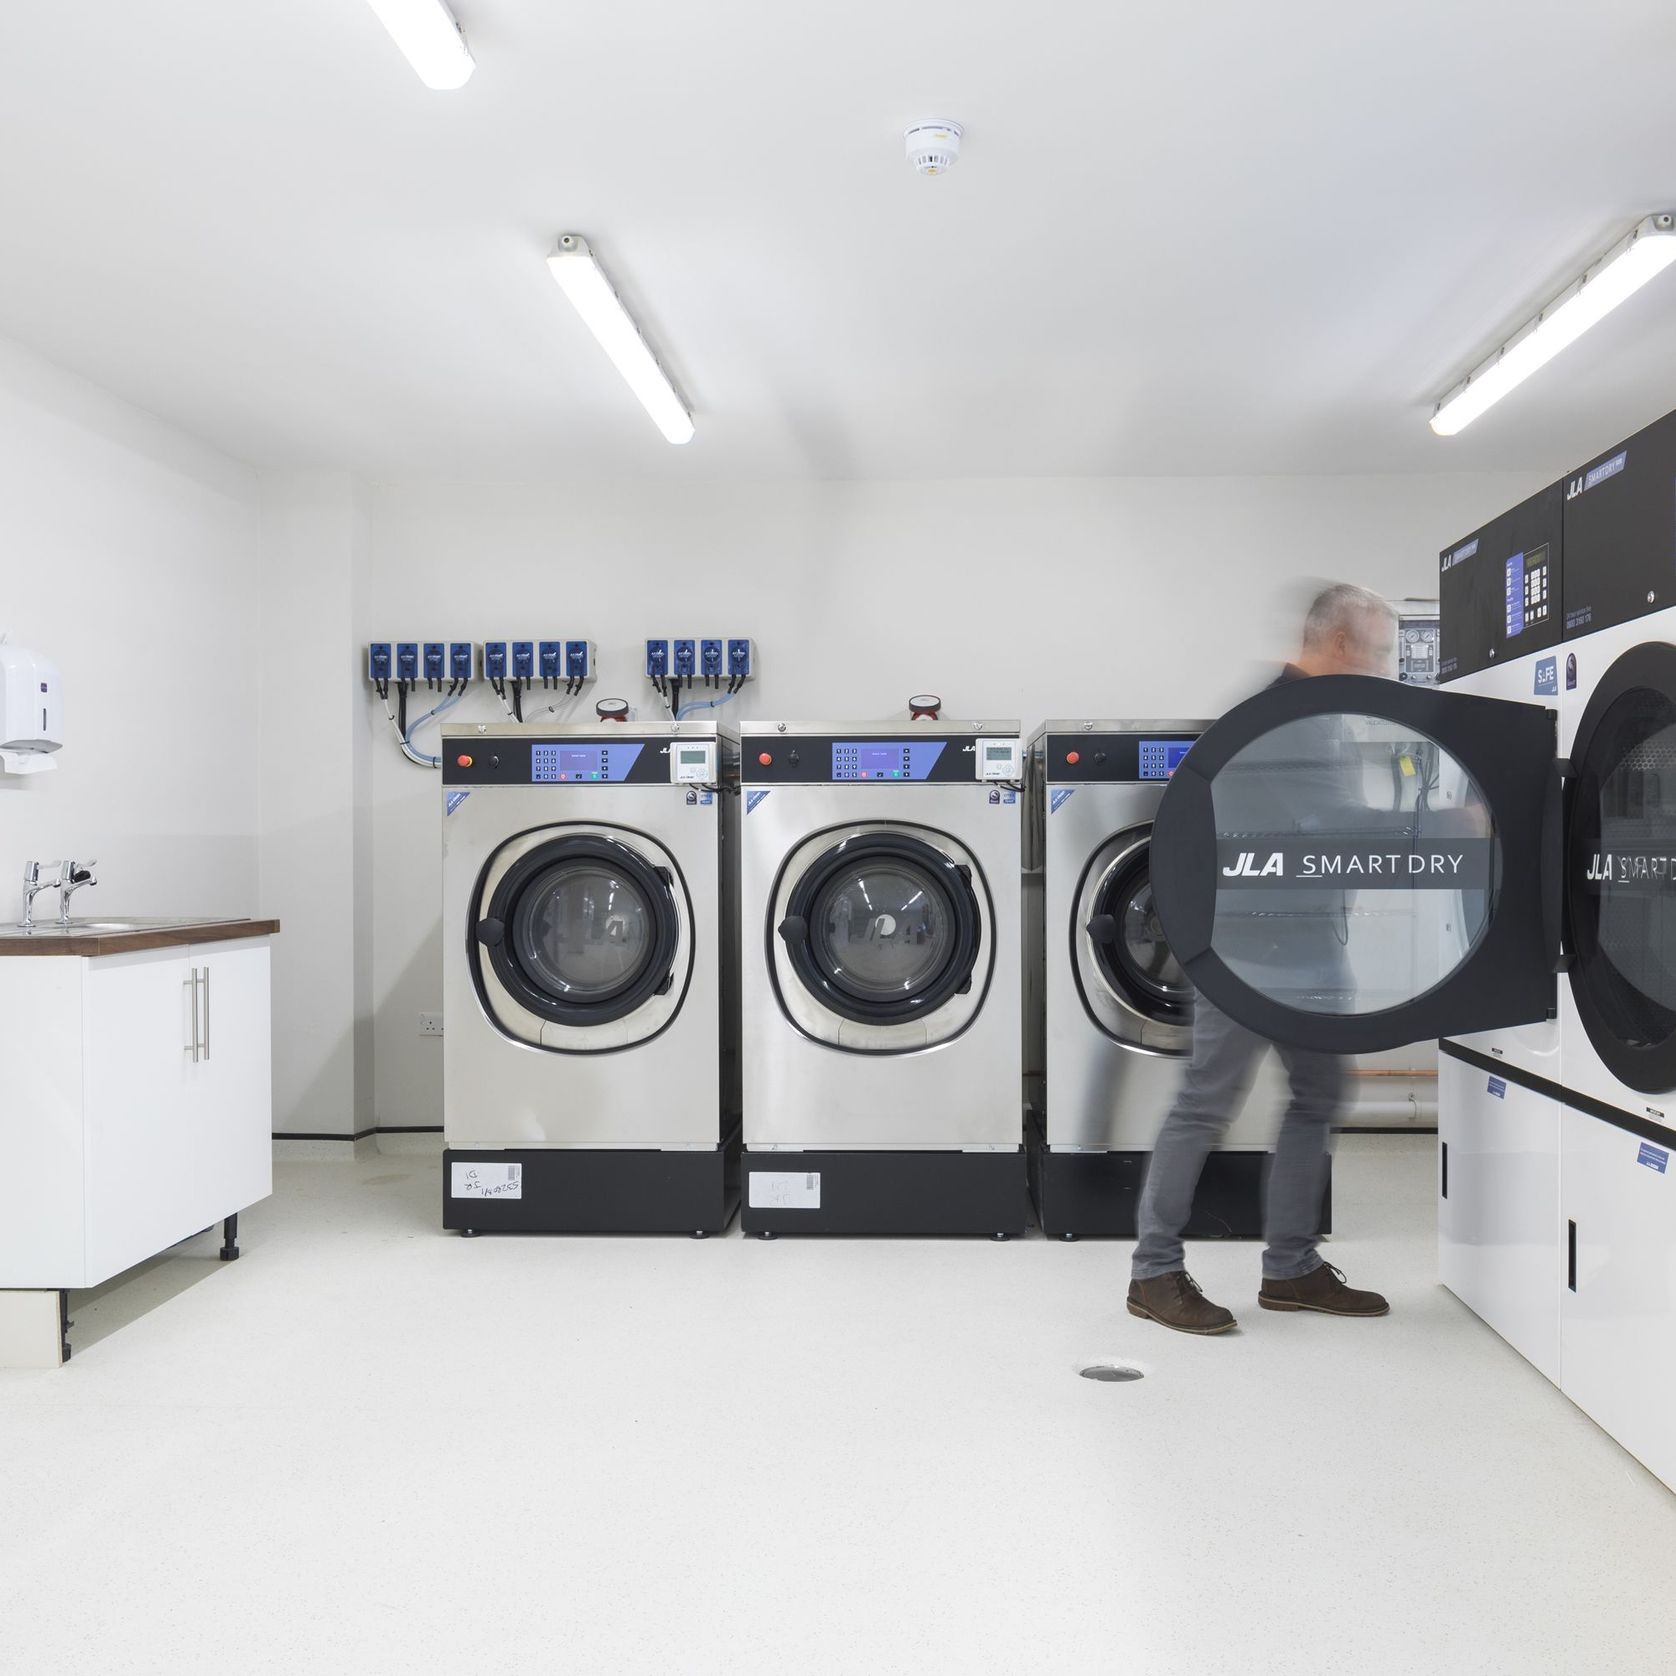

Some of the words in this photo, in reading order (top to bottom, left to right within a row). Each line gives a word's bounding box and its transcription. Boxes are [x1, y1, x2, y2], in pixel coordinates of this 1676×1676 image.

[1567, 477, 1583, 500] JLA
[1222, 852, 1284, 877] JLA
[1586, 853, 1613, 881] JLA
